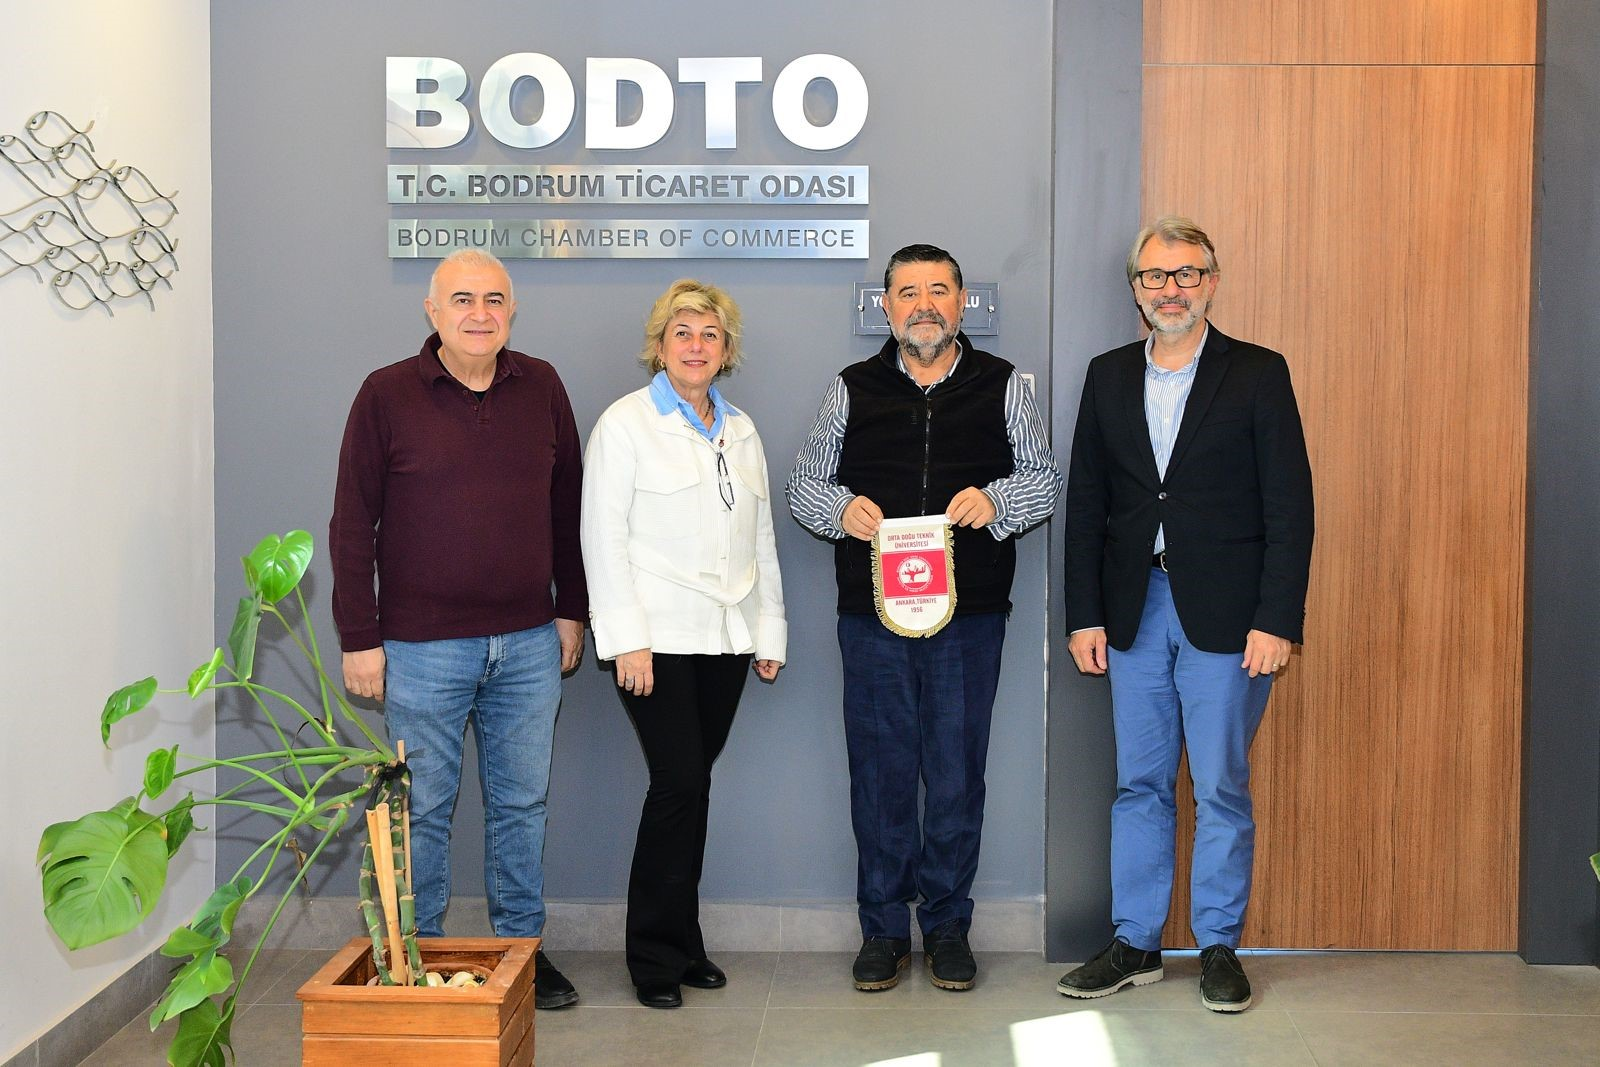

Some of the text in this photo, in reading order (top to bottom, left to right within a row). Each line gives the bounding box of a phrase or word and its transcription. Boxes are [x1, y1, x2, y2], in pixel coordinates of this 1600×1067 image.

[385, 52, 869, 151] BODTO
[397, 169, 855, 198] T.C. BODRUM TİCARET ODASI
[398, 229, 855, 248] BODRUM CHAMBER OF COMMERCE
